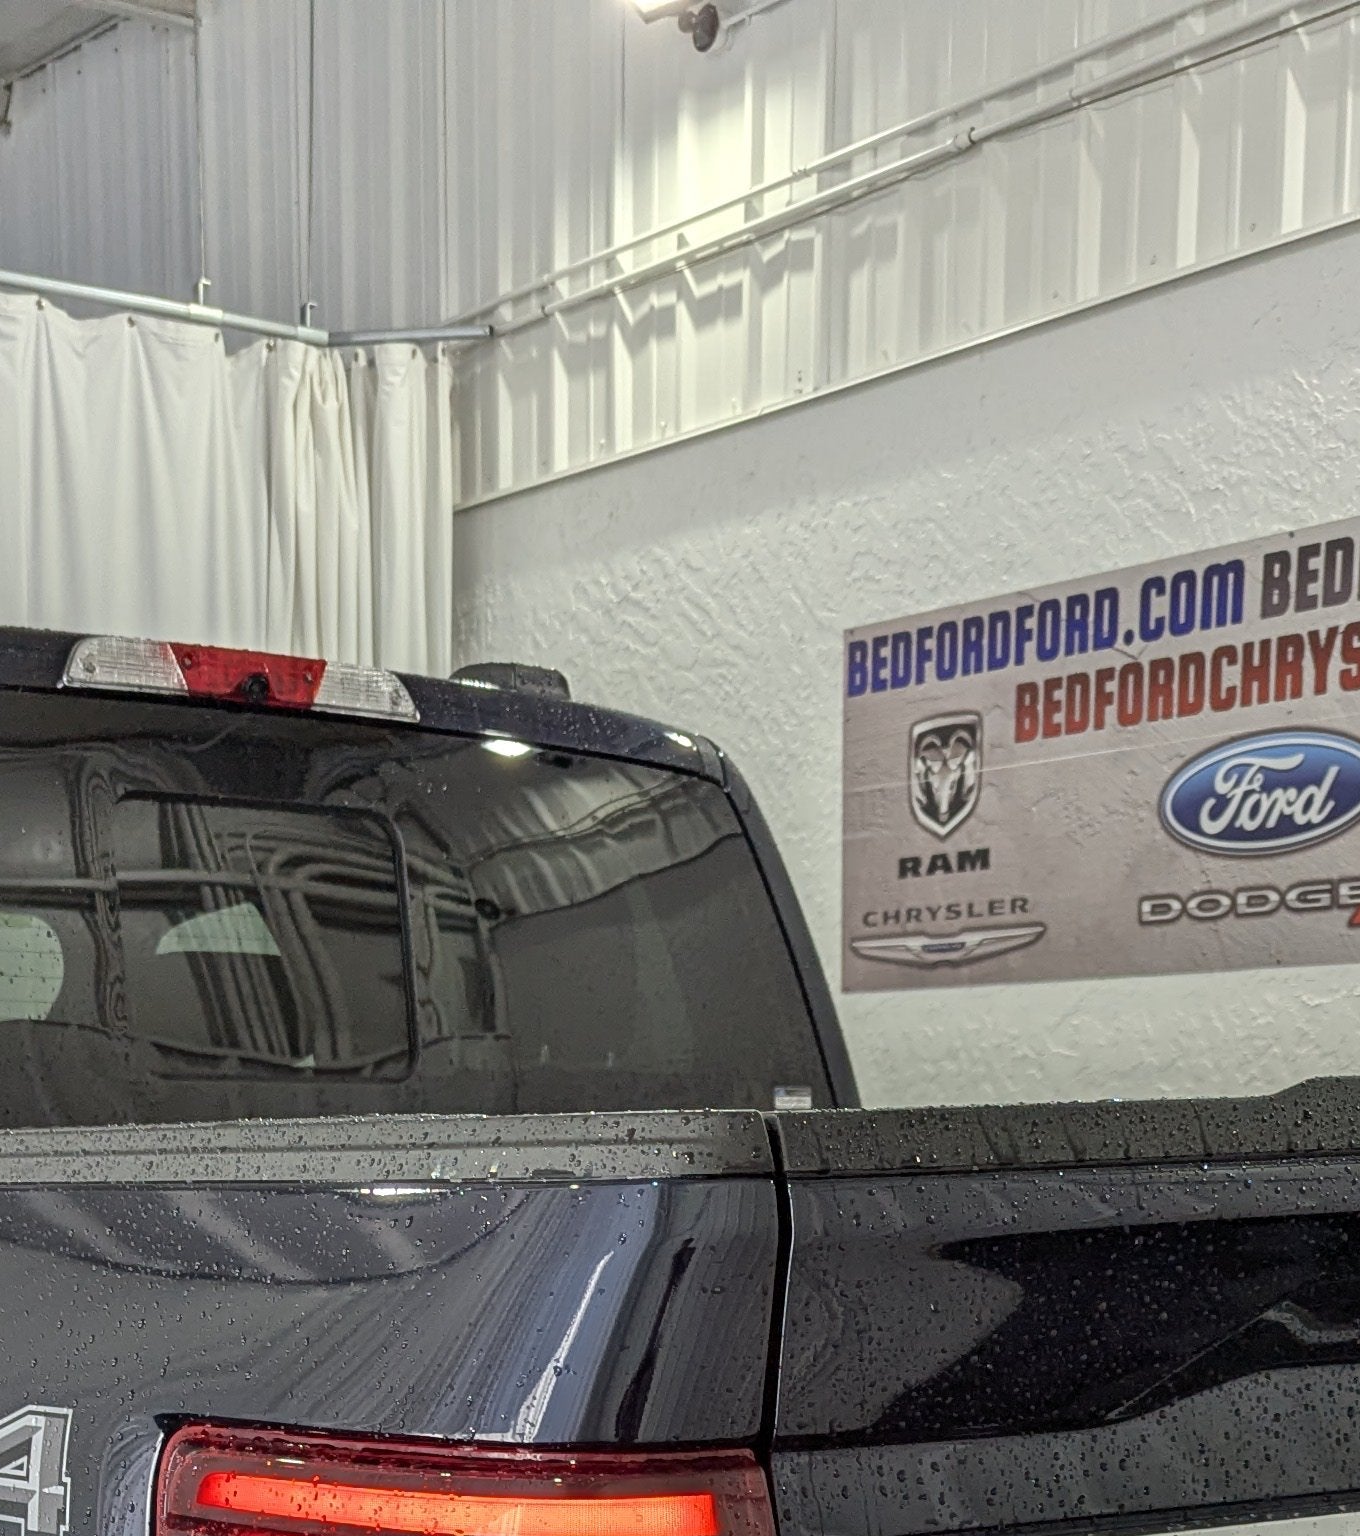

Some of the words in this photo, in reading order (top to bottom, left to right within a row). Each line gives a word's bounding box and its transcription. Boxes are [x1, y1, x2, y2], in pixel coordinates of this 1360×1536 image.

[847, 559, 1246, 698] BEDFORDFORD.COM
[1198, 753, 1340, 835] Ford
[897, 848, 990, 880] RAM
[861, 897, 1029, 928] CHRYSLER
